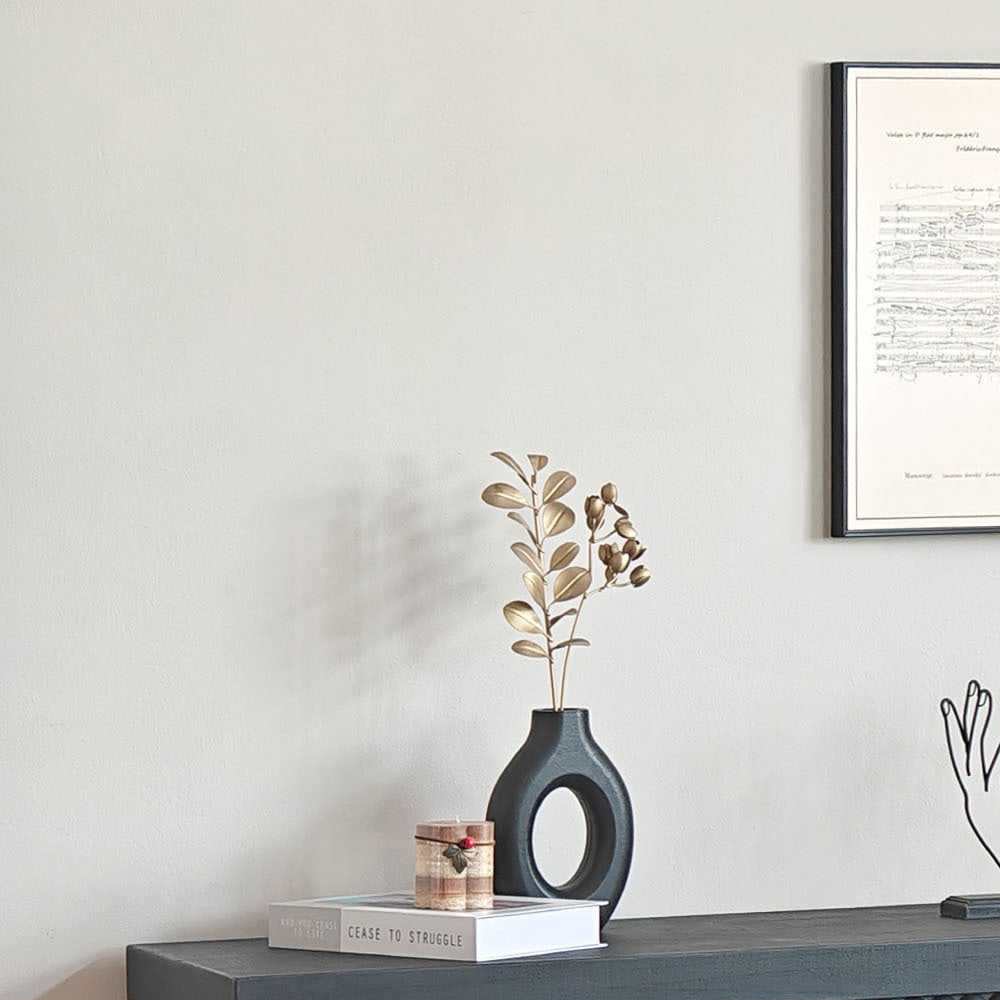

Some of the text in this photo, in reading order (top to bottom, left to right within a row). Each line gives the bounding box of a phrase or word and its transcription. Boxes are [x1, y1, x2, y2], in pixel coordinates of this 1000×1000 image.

[348, 926, 463, 948] CEASE TO STRUGGLE
